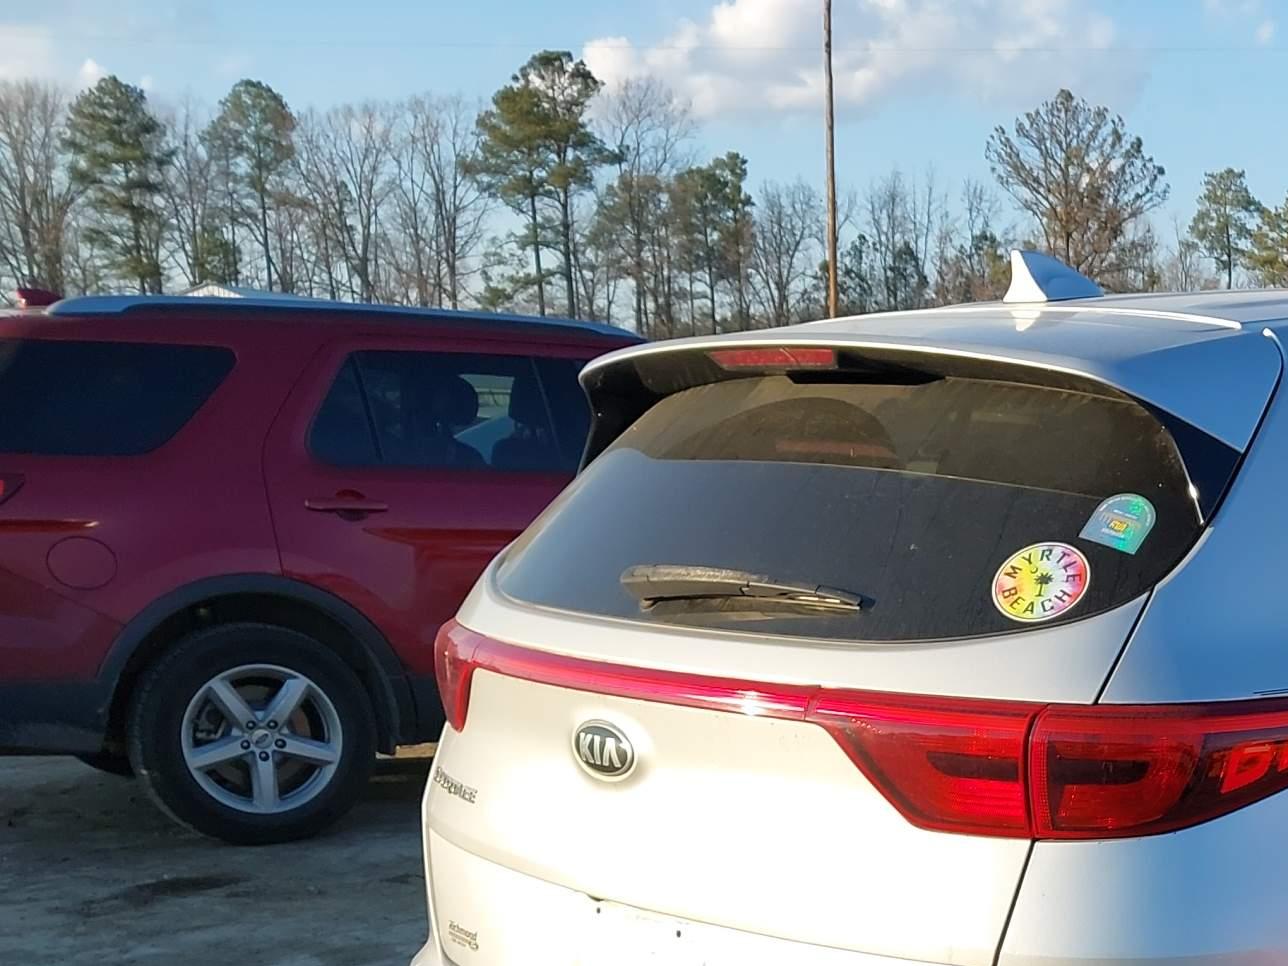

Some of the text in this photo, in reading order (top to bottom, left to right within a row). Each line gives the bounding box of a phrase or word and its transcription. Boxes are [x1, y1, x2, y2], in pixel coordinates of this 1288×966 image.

[1003, 548, 1082, 583] MYRTLE
[1001, 588, 1072, 615] BEACH
[579, 731, 622, 768] KIA
